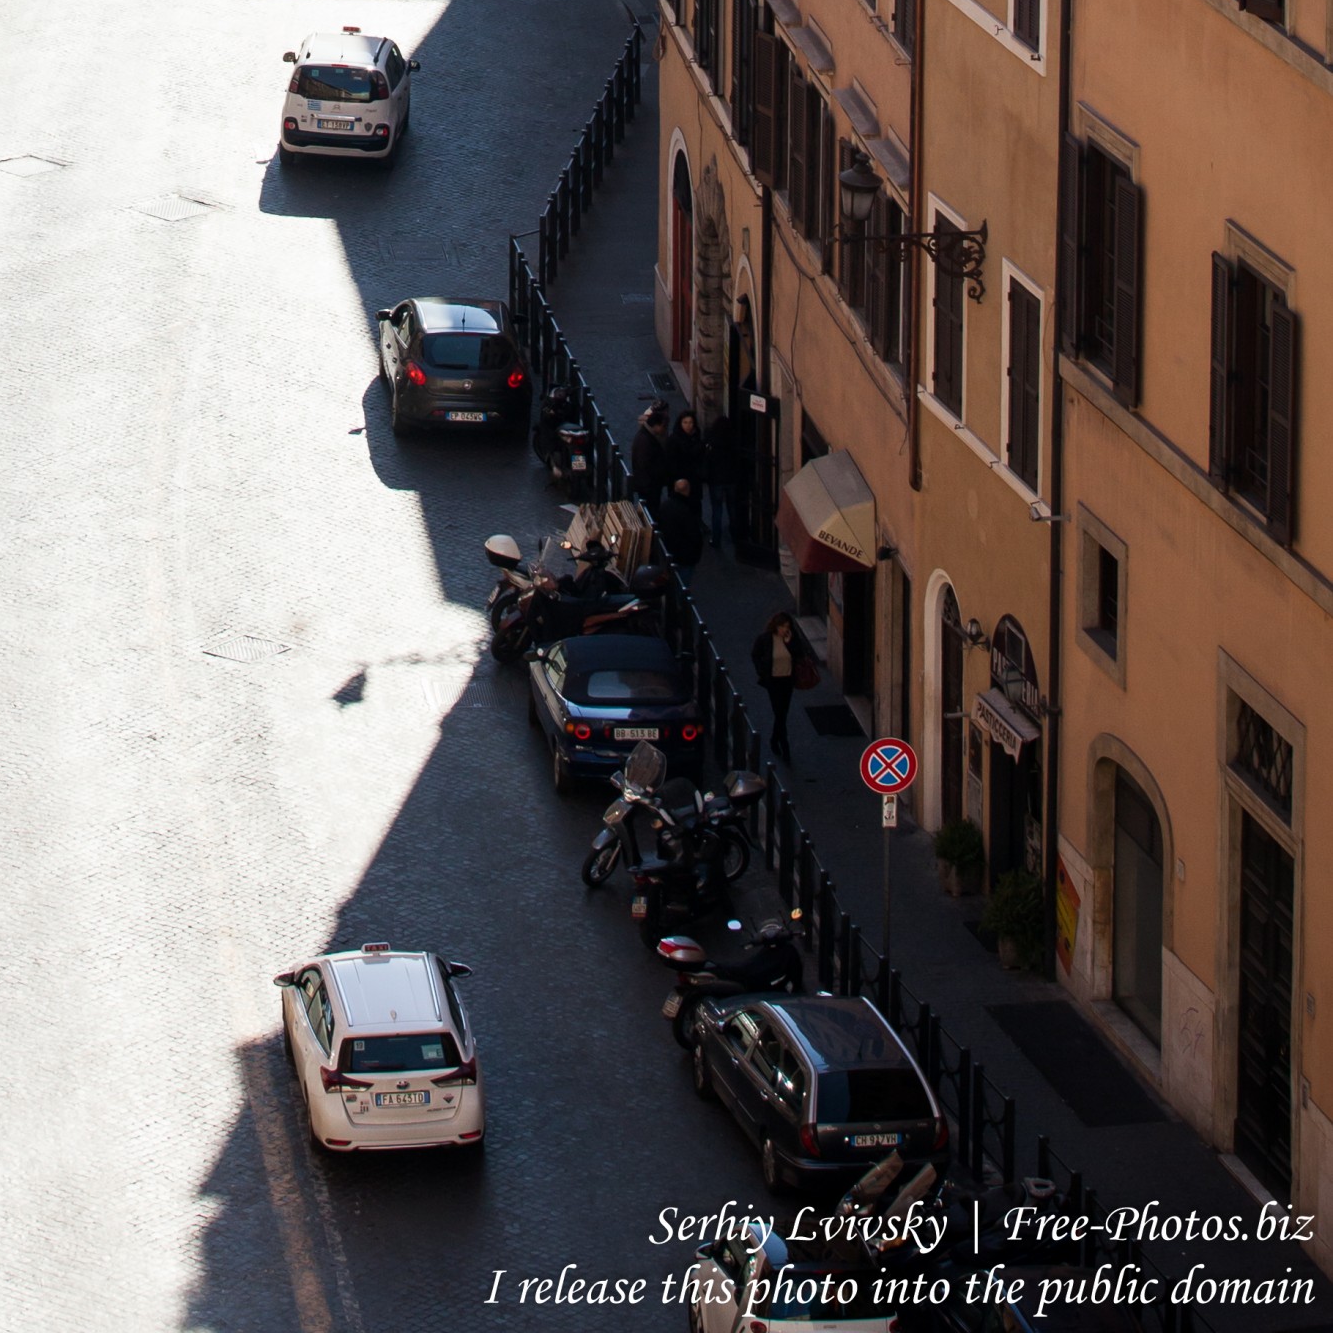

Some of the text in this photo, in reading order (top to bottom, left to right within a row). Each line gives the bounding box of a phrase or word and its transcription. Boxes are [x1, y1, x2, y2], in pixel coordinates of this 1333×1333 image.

[818, 530, 864, 559] BEVANDE
[976, 701, 1018, 751] PASTICCERIA
[382, 1094, 394, 1105] FA
